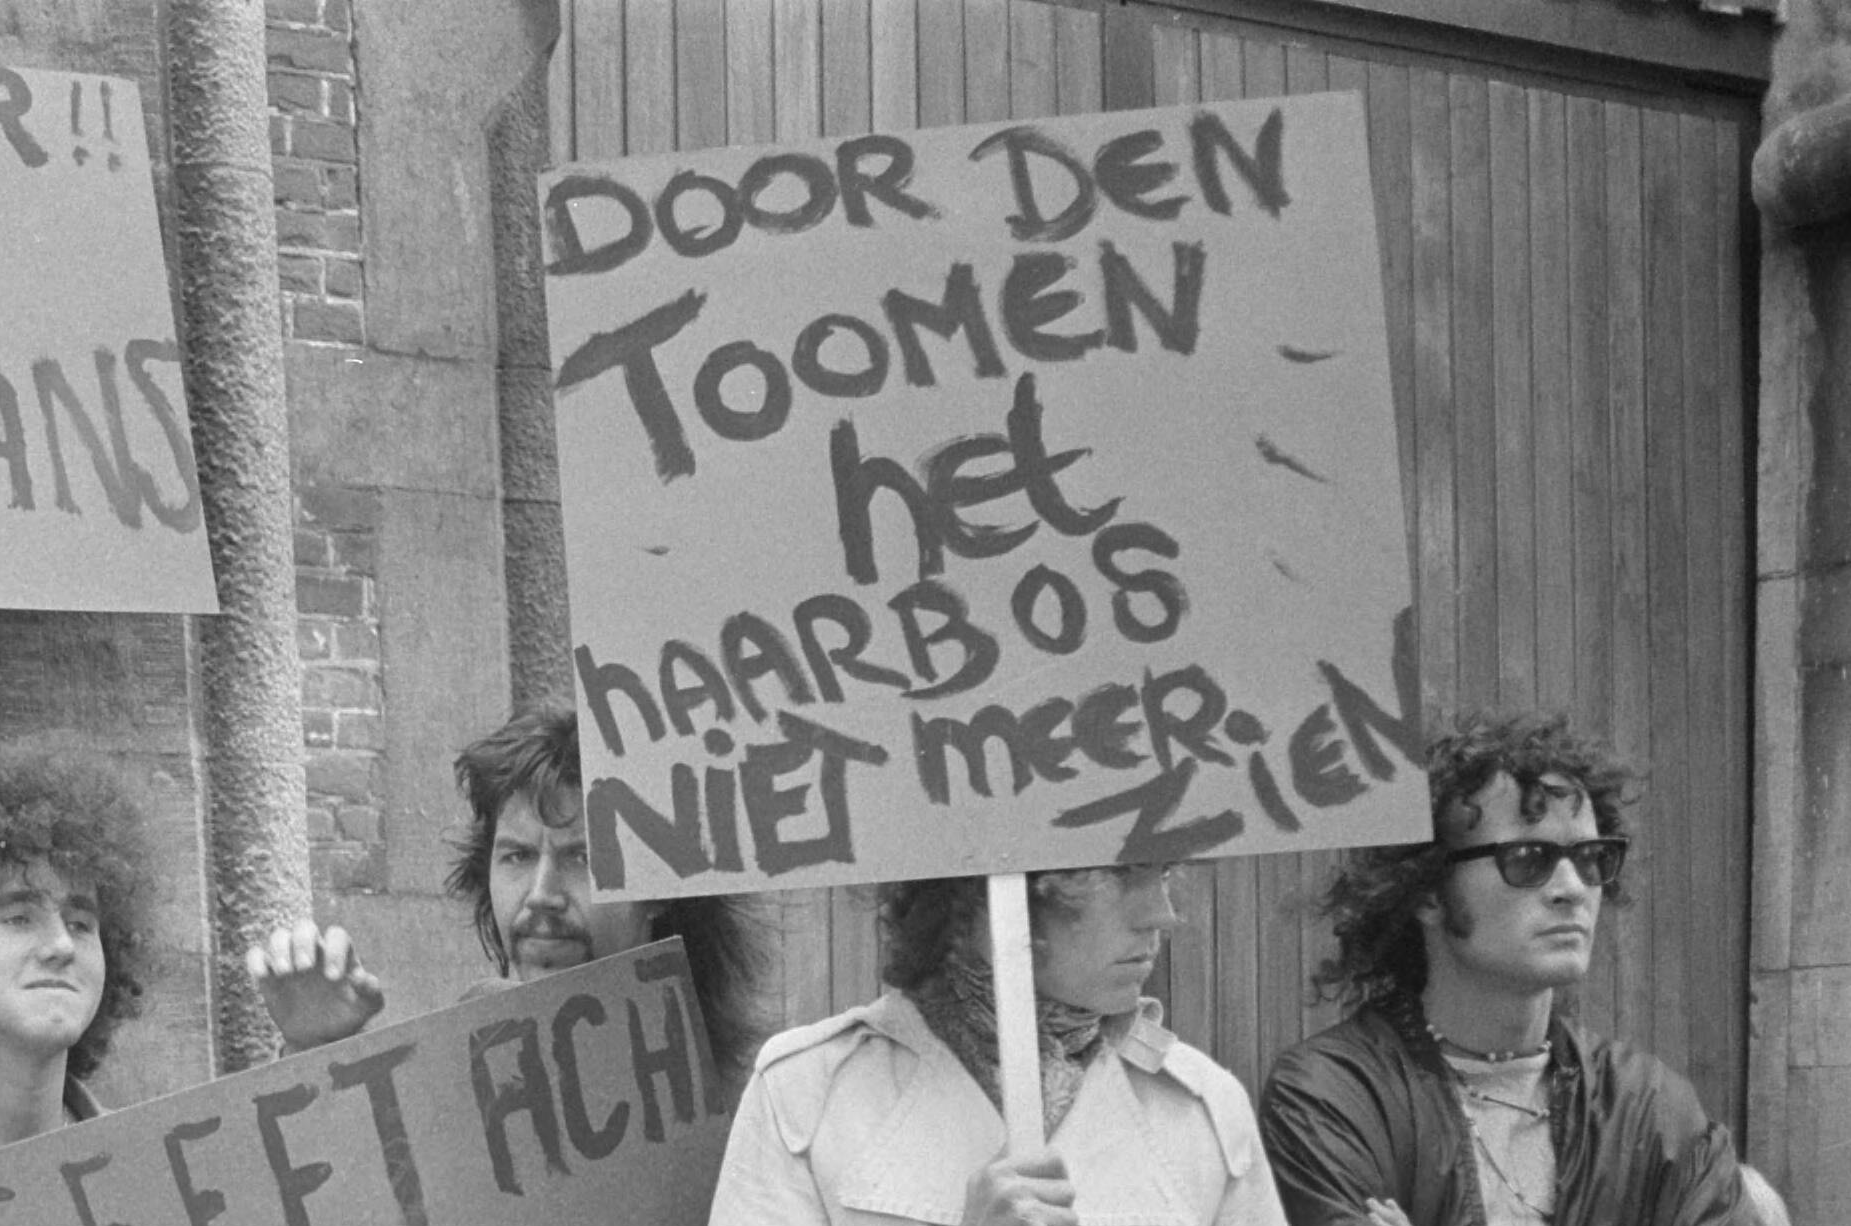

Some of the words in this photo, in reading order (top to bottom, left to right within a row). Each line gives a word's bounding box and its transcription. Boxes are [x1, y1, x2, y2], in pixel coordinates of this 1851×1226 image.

[544, 132, 941, 276] DOOR
[969, 107, 1292, 243] DEN
[553, 240, 1206, 485] TOOMEN
[830, 372, 1125, 586] het
[911, 664, 1235, 806] MEER
